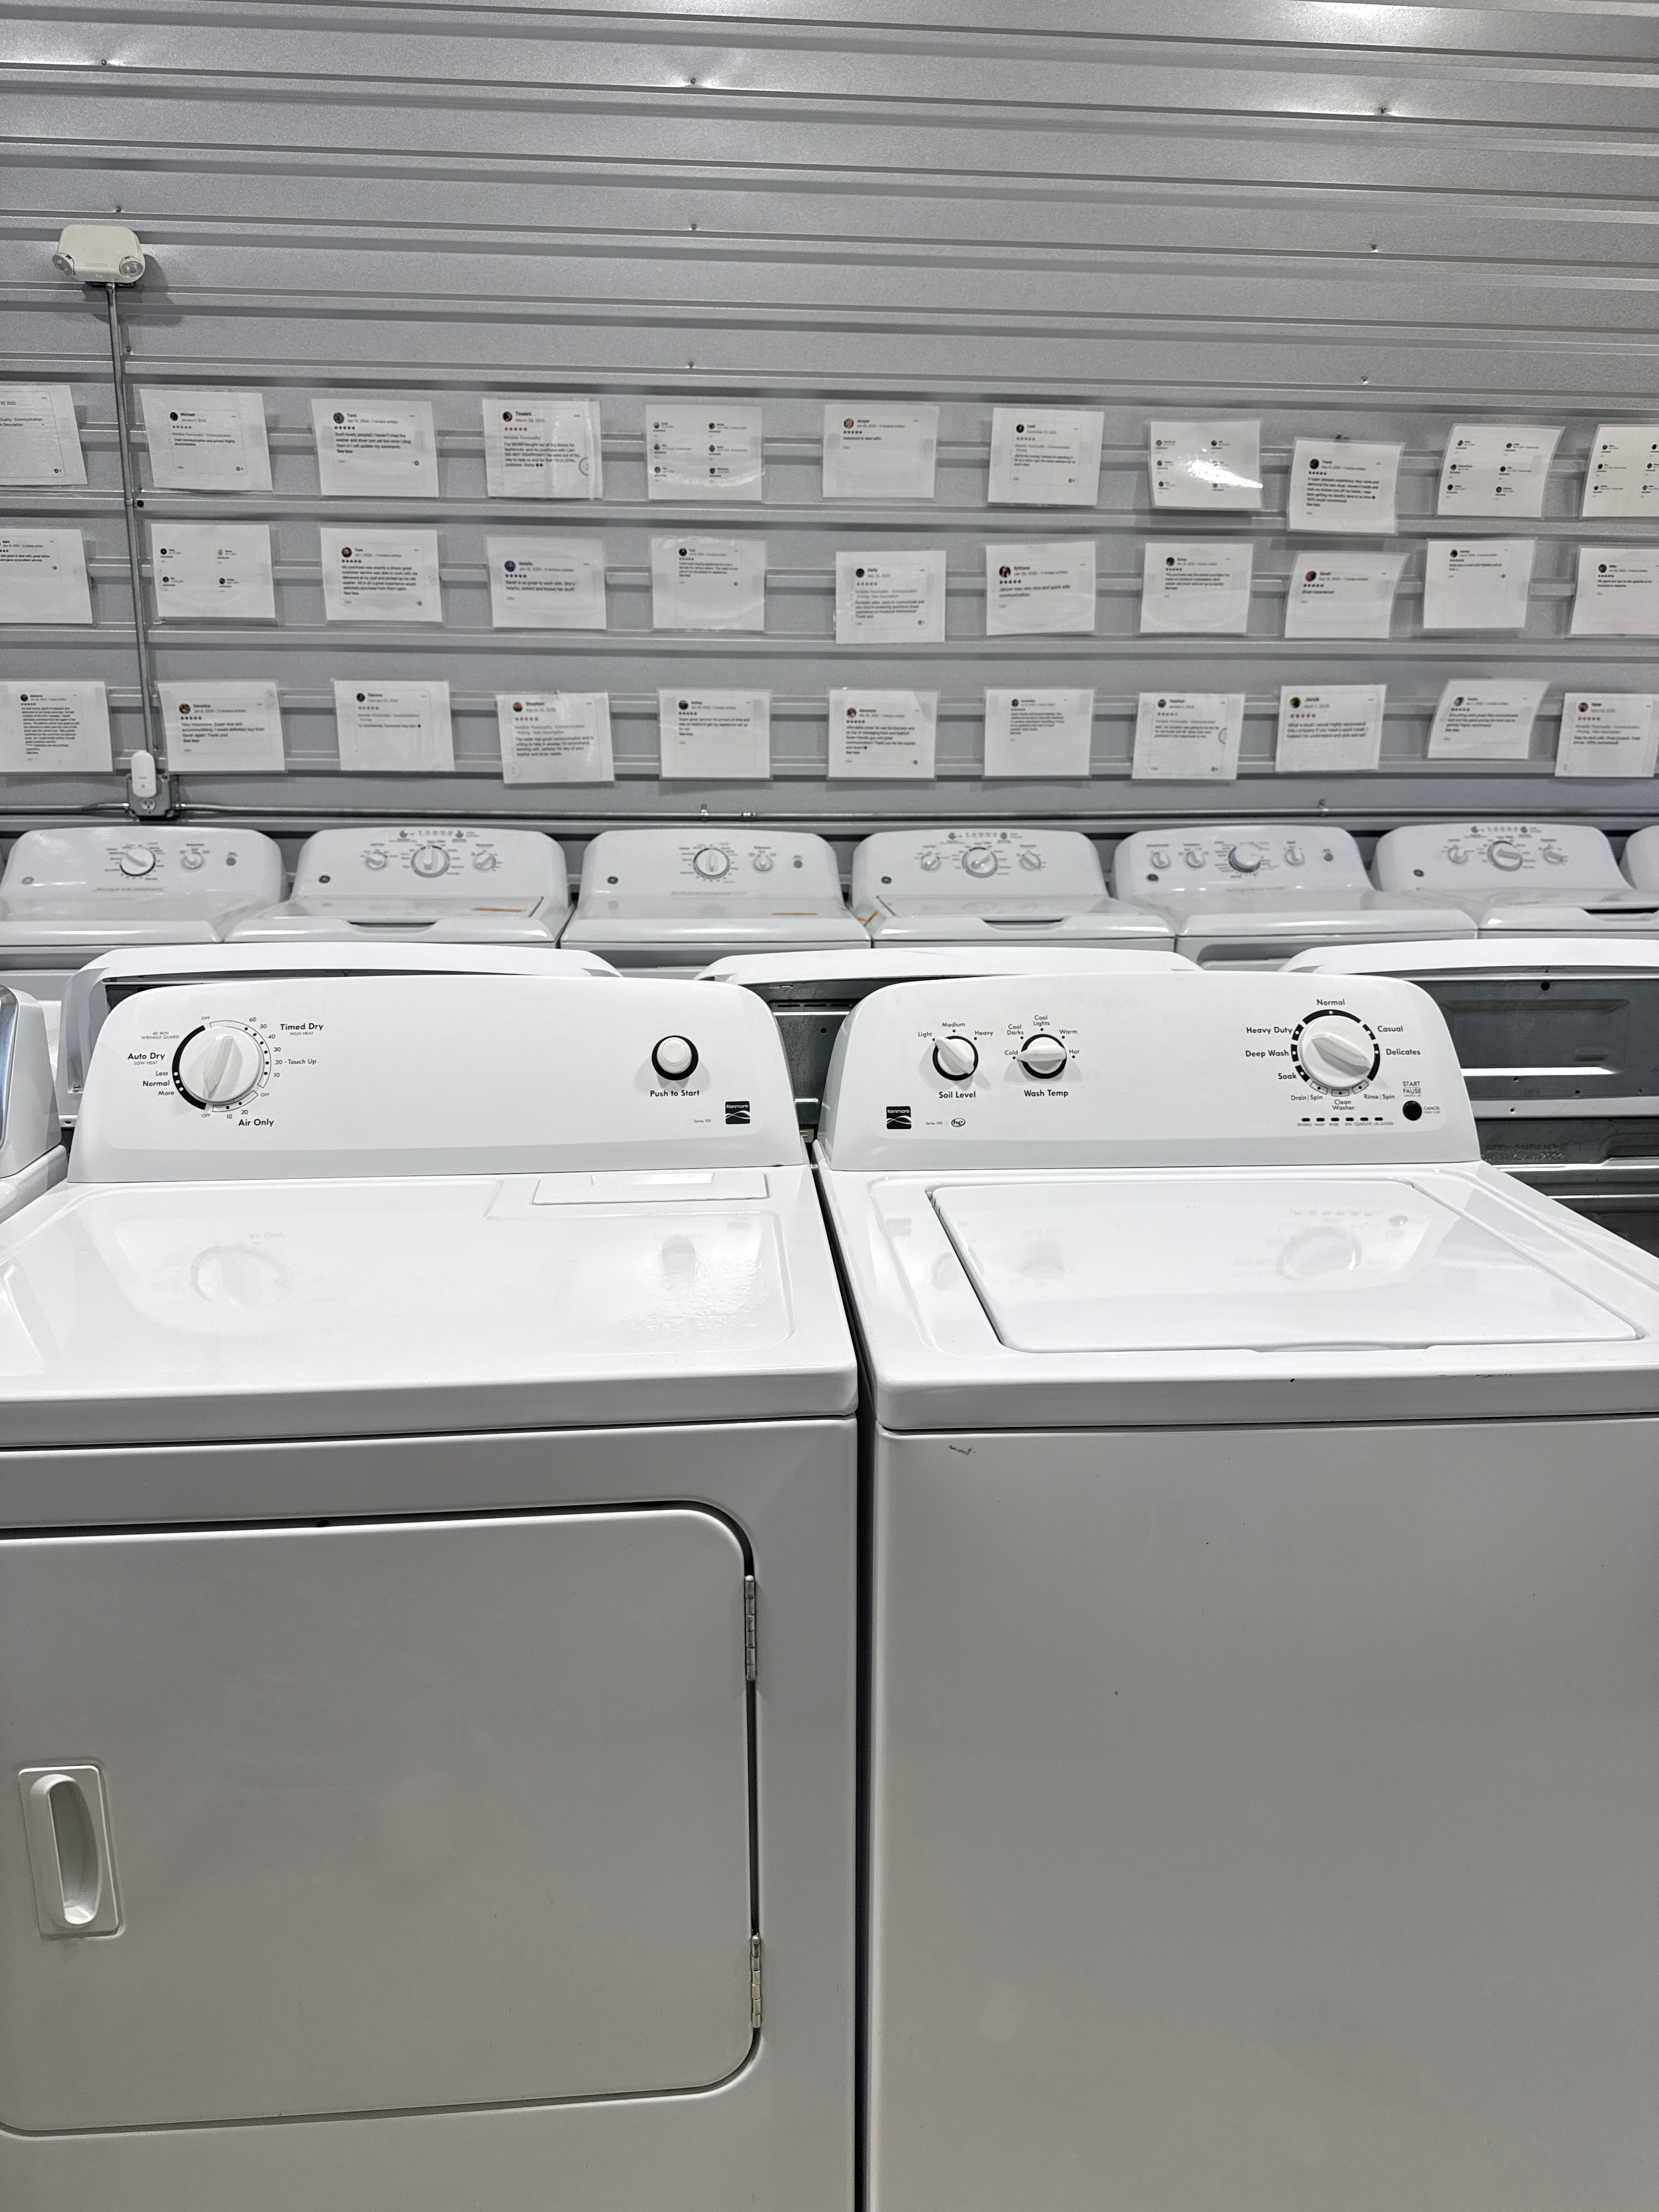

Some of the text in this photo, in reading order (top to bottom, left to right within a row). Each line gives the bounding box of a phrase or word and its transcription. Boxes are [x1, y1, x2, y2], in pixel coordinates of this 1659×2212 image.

[309, 1023, 324, 1032] Dry
[150, 1052, 165, 1060] Dry
[1246, 1050, 1266, 1058] Deep
[1047, 1090, 1068, 1098] Temp
[254, 1118, 274, 1127] Only
